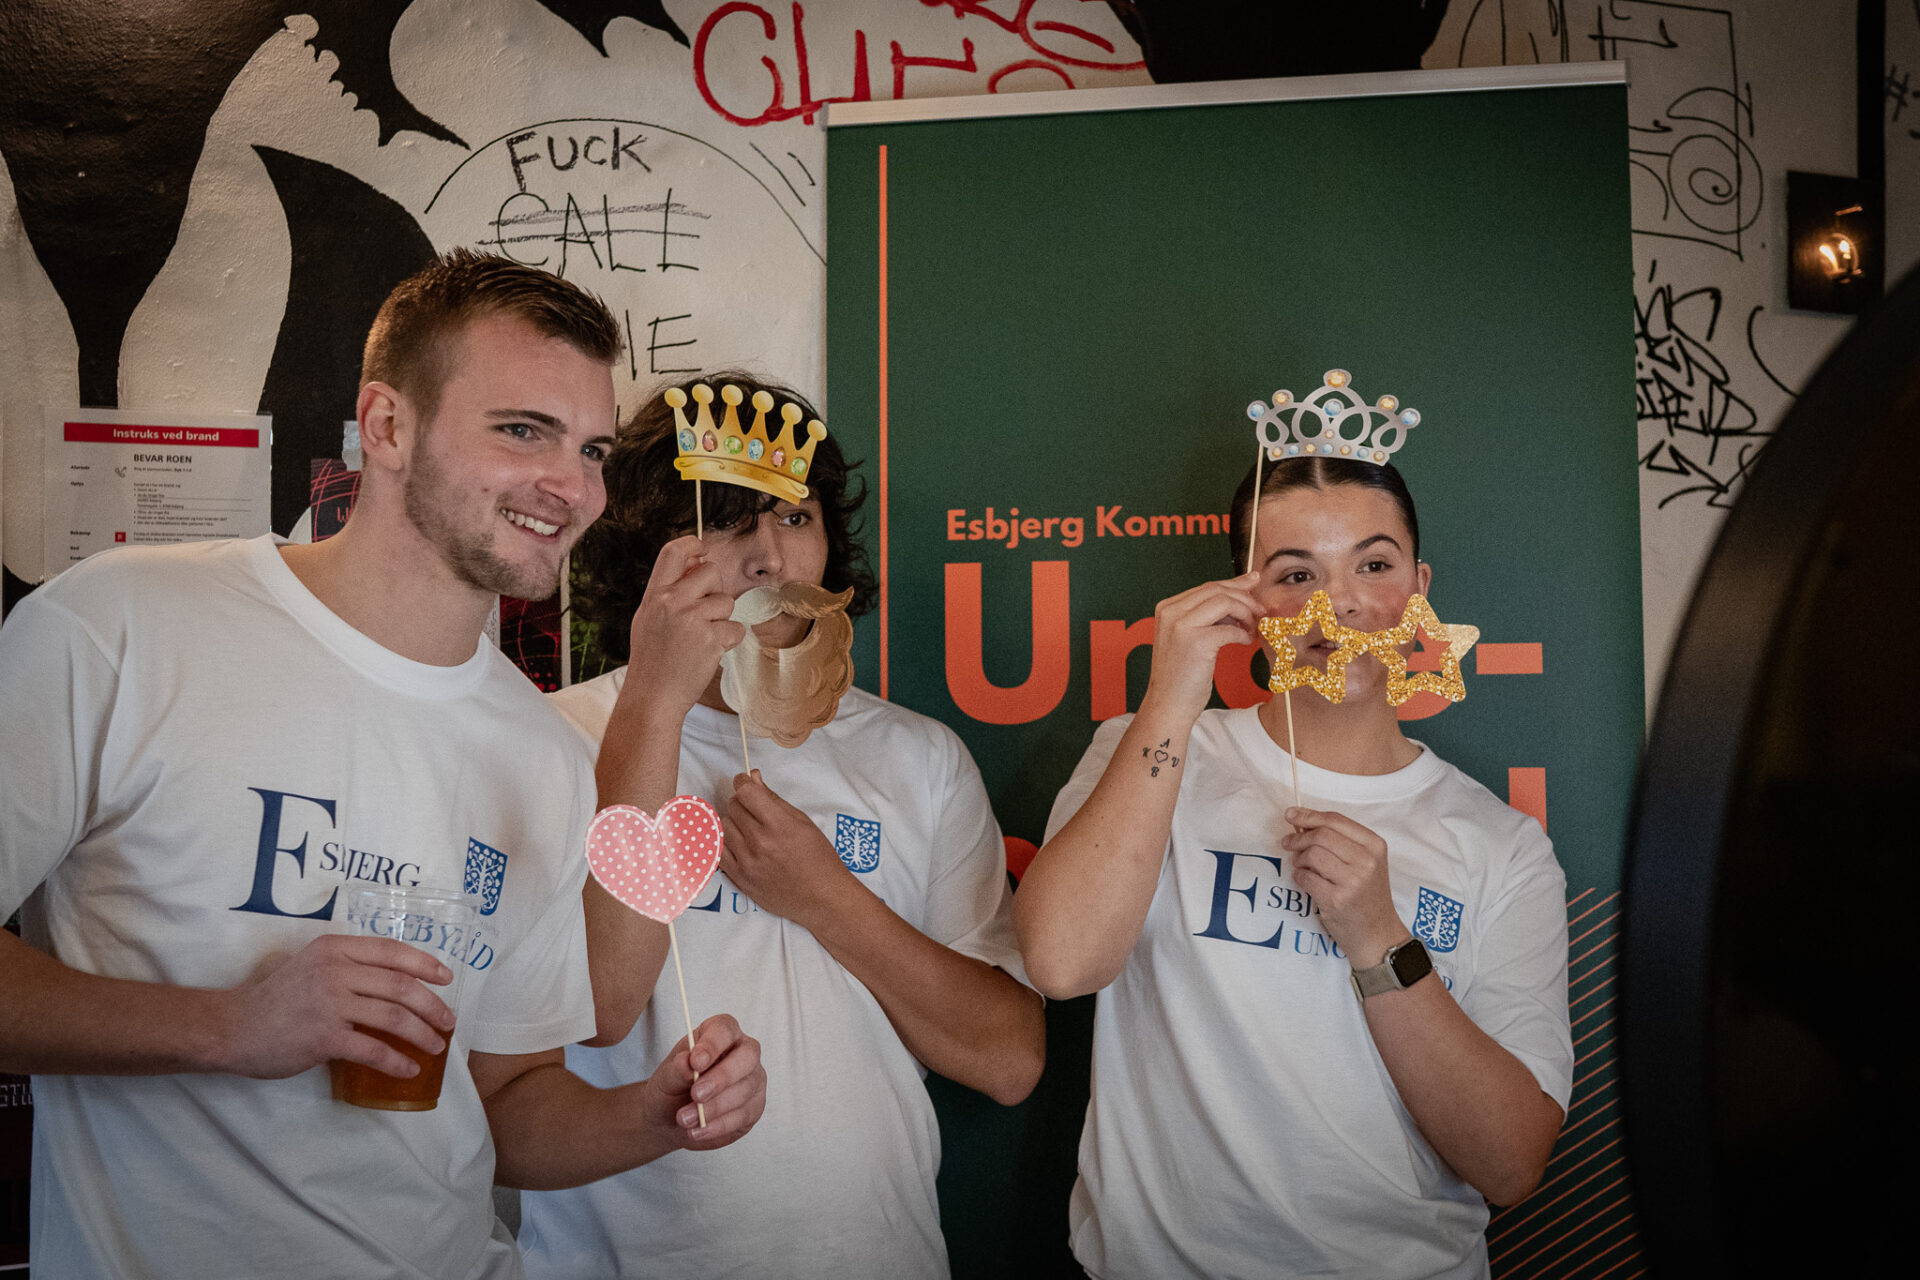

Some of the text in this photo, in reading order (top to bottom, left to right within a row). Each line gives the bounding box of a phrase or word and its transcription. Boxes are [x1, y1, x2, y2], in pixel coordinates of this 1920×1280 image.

[506, 126, 652, 193] FUCK
[113, 428, 220, 442] Instruks ved brand
[133, 453, 192, 464] BEVAR ROEN
[947, 507, 1084, 549] Esbjerg
[1193, 849, 1321, 949] ESBJ
